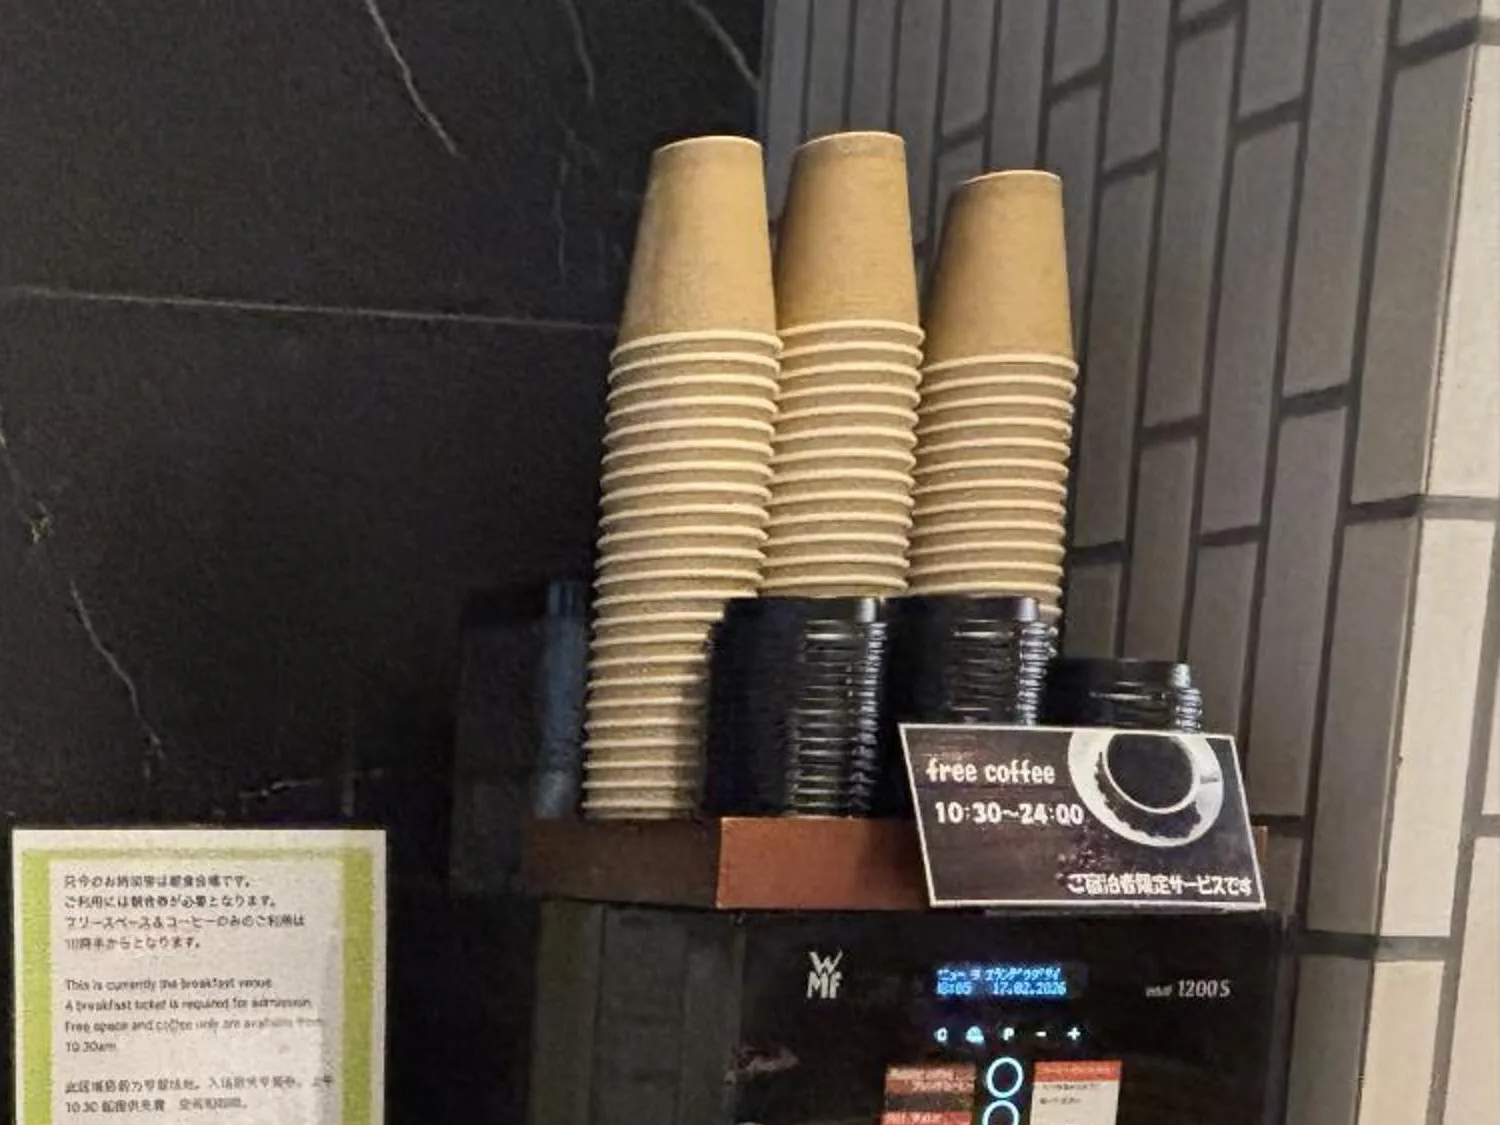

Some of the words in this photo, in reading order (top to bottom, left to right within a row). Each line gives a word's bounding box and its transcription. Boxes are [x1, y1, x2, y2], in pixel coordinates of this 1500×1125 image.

[926, 757, 977, 784] free
[984, 759, 1056, 785] coffee
[1067, 873, 1253, 897] ご宿泊者限定サービスです
[66, 978, 90, 992] This
[807, 949, 843, 999] WMF
